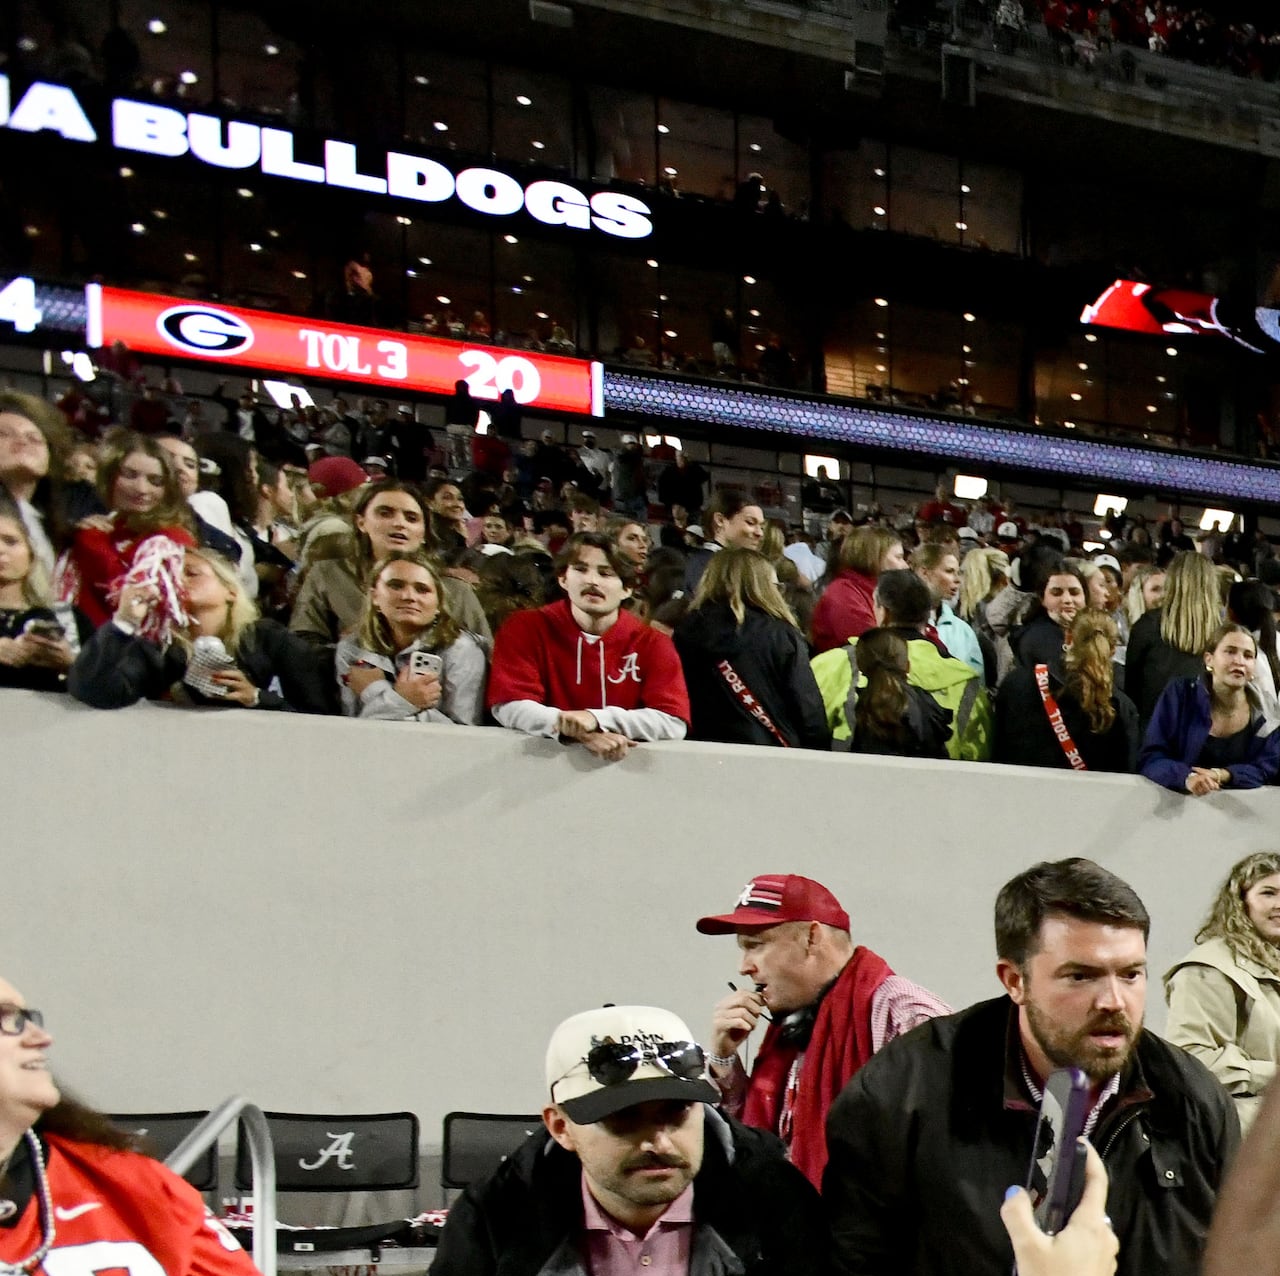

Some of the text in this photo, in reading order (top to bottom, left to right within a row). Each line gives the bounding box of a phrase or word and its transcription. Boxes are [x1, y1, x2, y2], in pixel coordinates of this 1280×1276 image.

[112, 98, 653, 239] BULLDOGS
[300, 328, 372, 375] TOL
[376, 341, 408, 379] 3
[458, 350, 542, 405] 20
[607, 652, 642, 684] A
[1048, 708, 1071, 742] ROLL
[620, 1033, 664, 1045] DAMN
[299, 1131, 356, 1171] A
